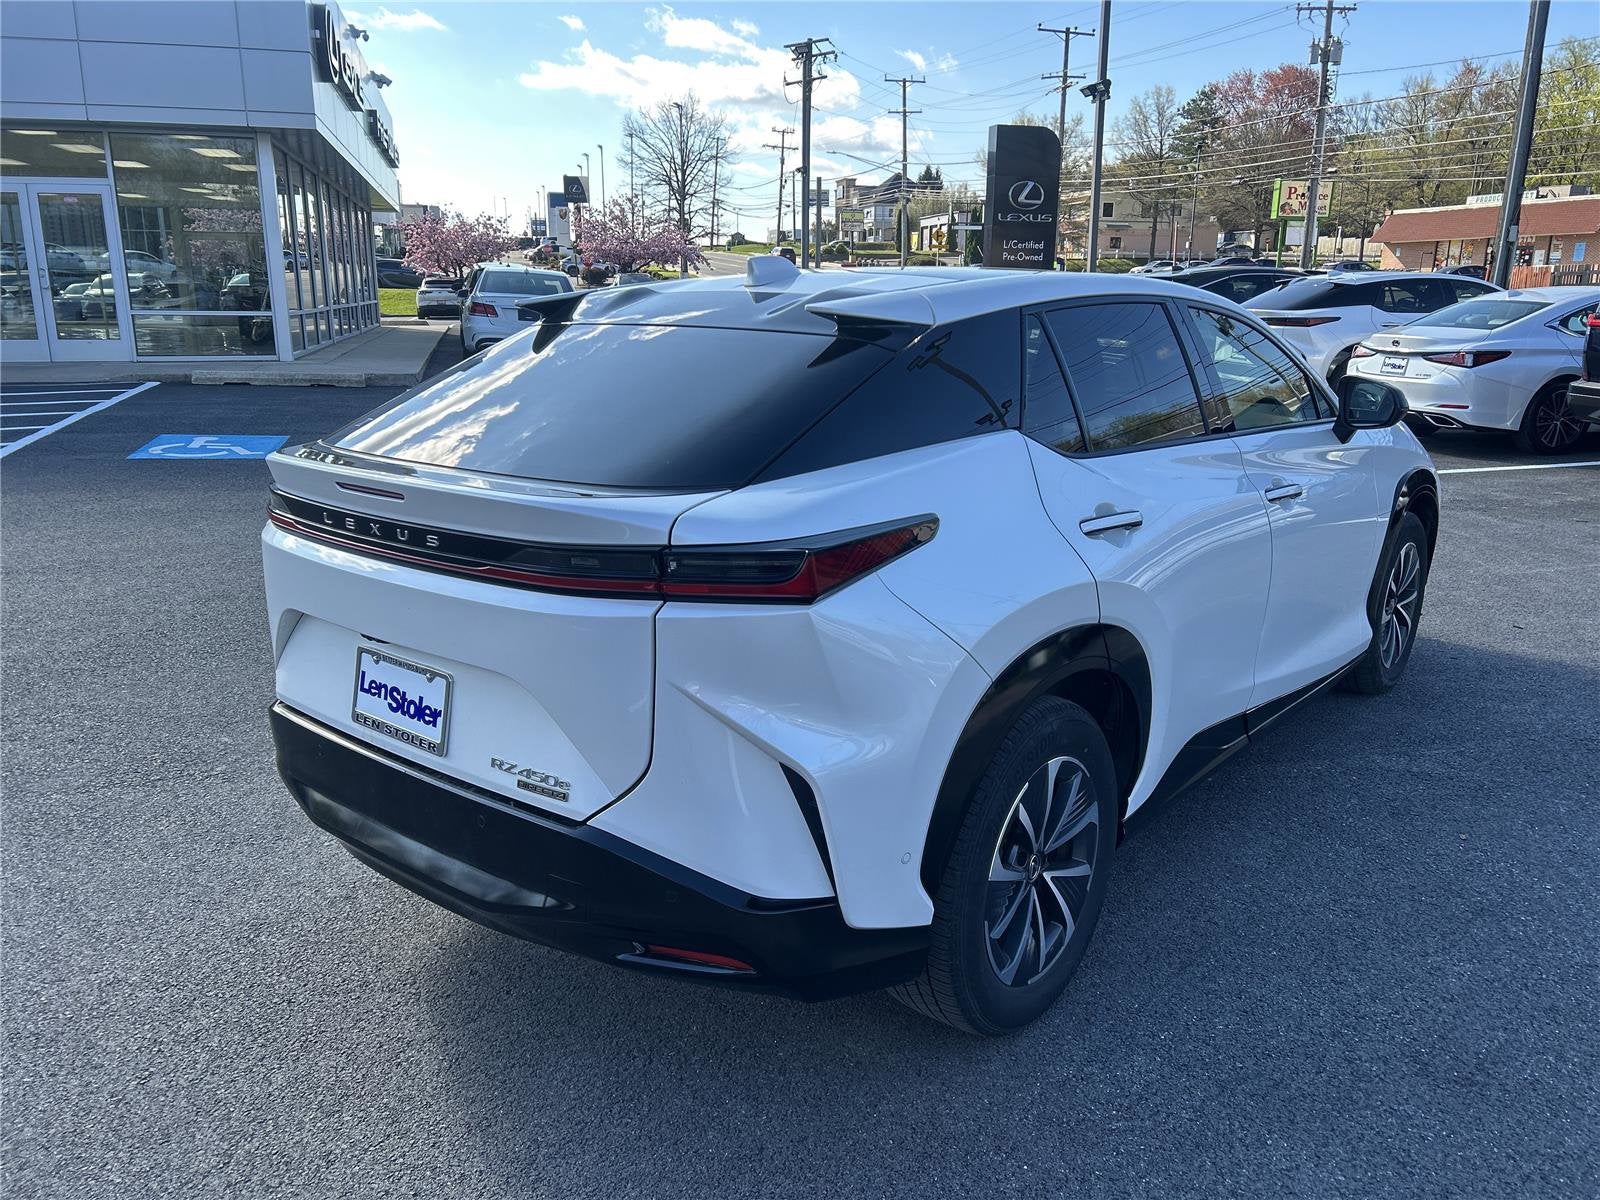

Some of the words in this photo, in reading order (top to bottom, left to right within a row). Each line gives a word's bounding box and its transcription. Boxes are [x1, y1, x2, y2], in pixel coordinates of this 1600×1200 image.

[1287, 187, 1328, 200] Proce
[998, 213, 1052, 222] LEXUS
[1003, 240, 1044, 249] L/Certified
[1003, 252, 1043, 261] Pre-Owned
[323, 512, 439, 547] LEXUS
[356, 713, 380, 730] LEN
[385, 724, 437, 753] STOLER
